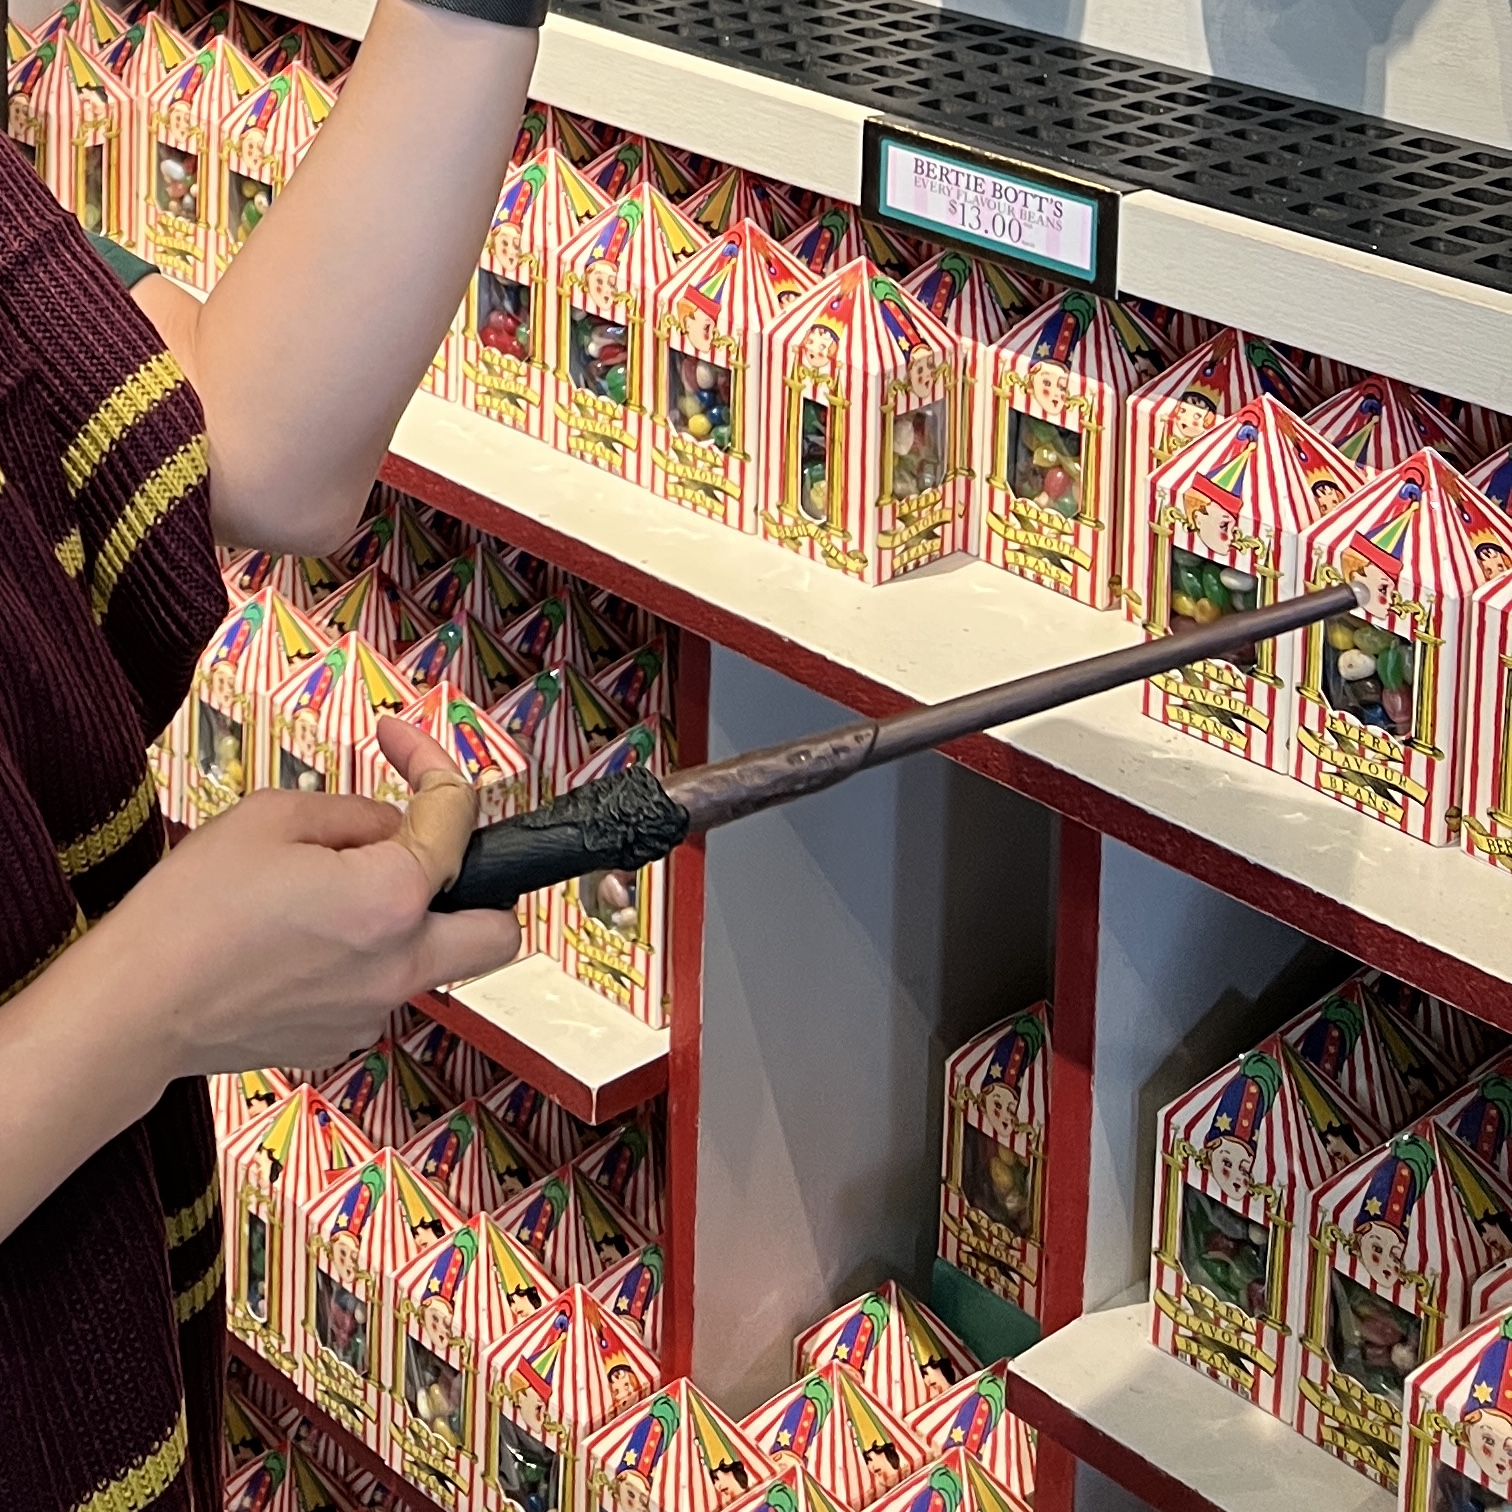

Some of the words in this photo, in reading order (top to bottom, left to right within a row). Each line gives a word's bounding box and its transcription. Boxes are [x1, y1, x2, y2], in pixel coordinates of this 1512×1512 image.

[913, 157, 986, 195] BERTIE
[991, 181, 1063, 219] BOTT'S
[914, 176, 954, 198] EVERY
[957, 188, 1016, 218] FLAVOUR
[1019, 206, 1063, 232] BEANS
[948, 199, 1023, 244] $13.00
[1014, 501, 1067, 530] EVERY
[1004, 524, 1075, 557] FLAVOUR
[1014, 552, 1061, 580] BEANS
[1203, 660, 1241, 686] ERY
[1164, 676, 1250, 719] FLAVOUR
[1177, 709, 1233, 742] BEANS
[1329, 714, 1398, 758] EVERY
[1317, 743, 1408, 788] FLAVOUR
[1330, 776, 1389, 812] BEANS
[1186, 1282, 1249, 1327] EVERY
[1174, 1308, 1258, 1358] FLAVOUR
[1185, 1339, 1241, 1379] BEANS
[1332, 1371, 1399, 1420] EVERY
[1320, 1397, 1395, 1443] FLAVOU
